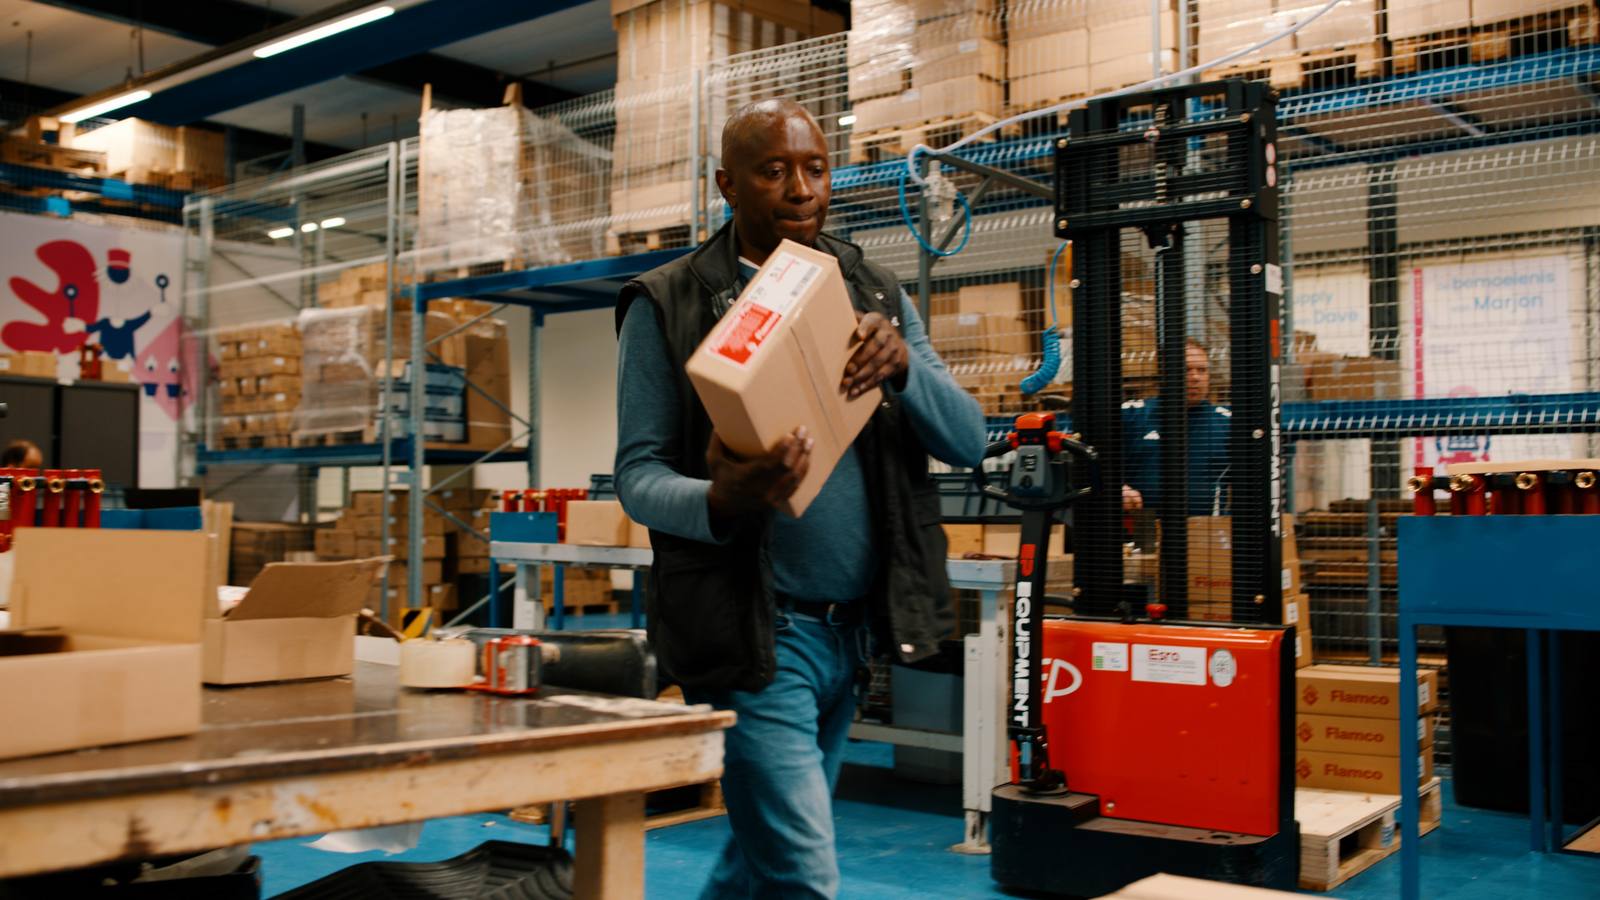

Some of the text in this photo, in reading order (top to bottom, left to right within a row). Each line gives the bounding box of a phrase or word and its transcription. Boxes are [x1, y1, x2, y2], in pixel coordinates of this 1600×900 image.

[1473, 295, 1544, 313] Marjon
[1013, 581, 1032, 728] EQUIPMENT
[1330, 689, 1390, 705] Flamco
[1325, 726, 1385, 743] Flamco
[1323, 763, 1384, 780] Flamco
